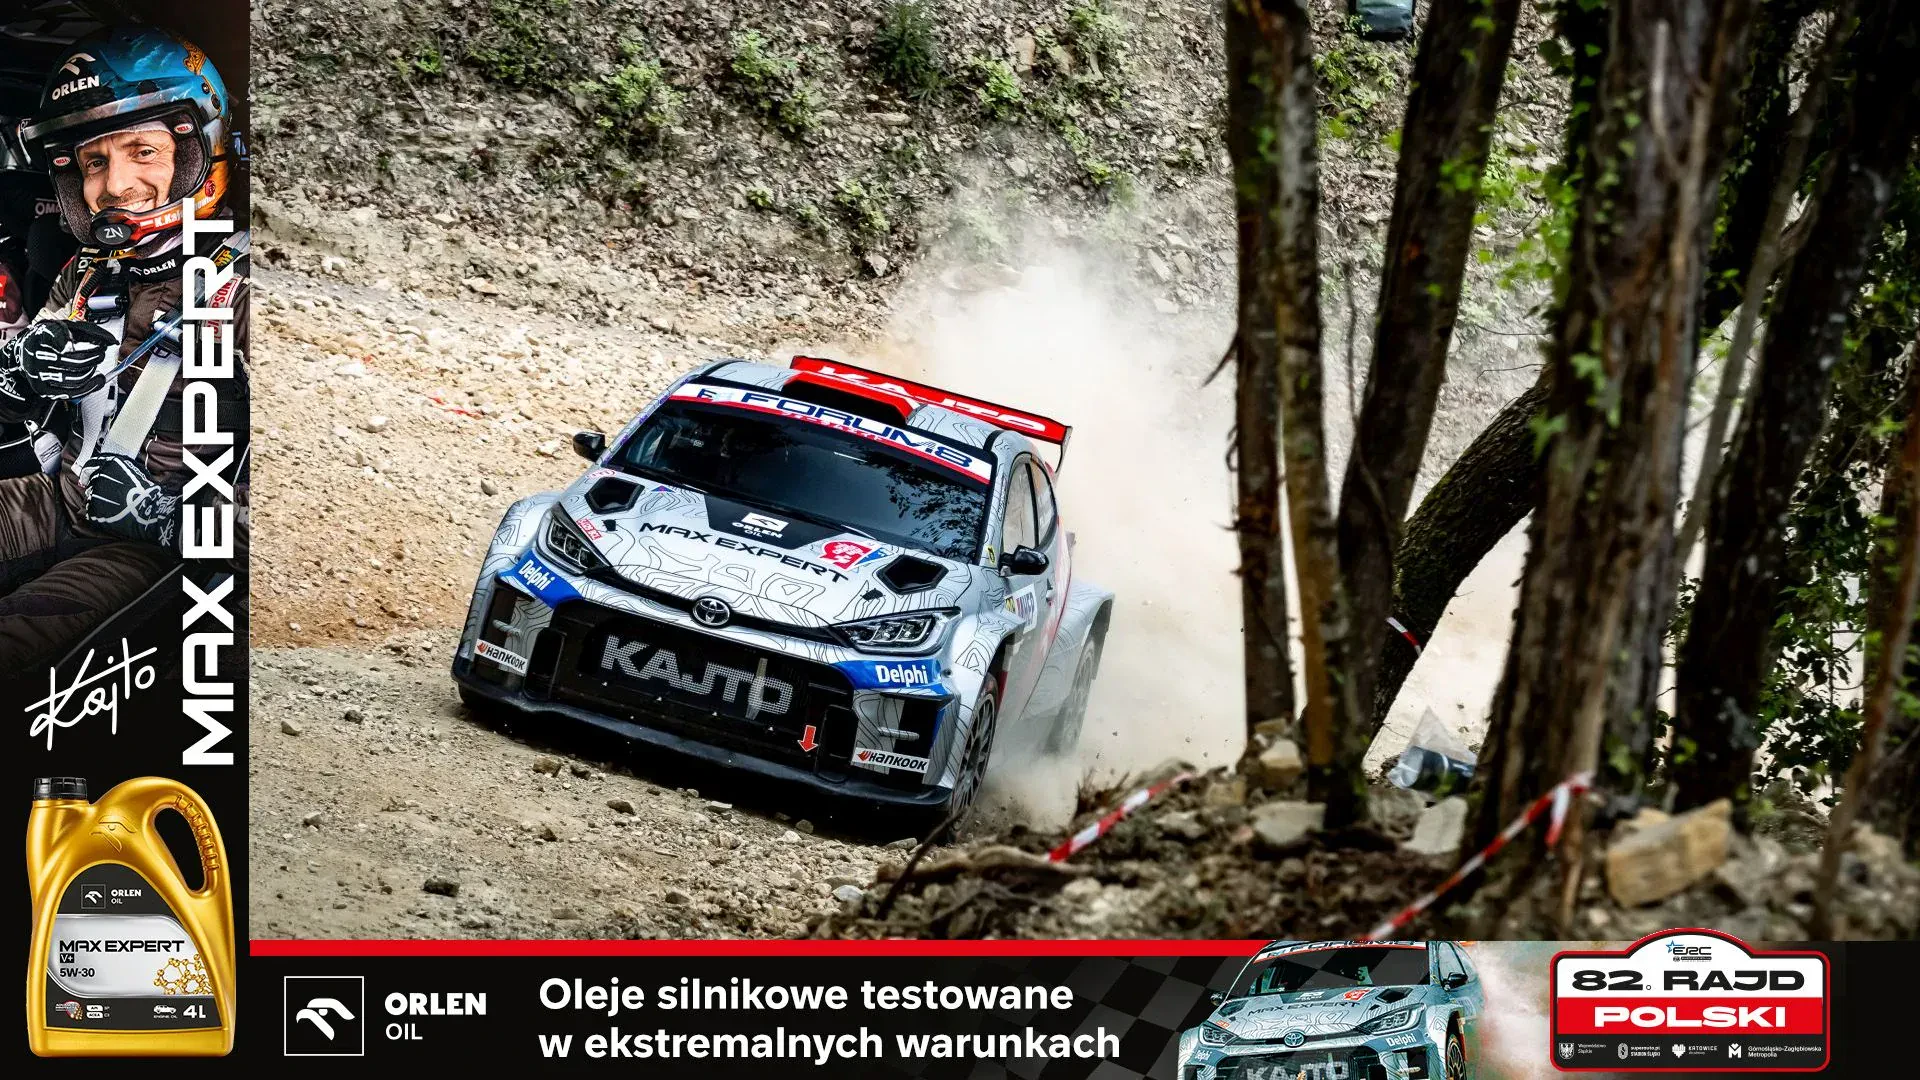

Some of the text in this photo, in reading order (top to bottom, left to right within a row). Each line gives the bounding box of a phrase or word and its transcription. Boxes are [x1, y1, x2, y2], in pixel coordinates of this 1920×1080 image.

[51, 75, 100, 100] ORLEN
[143, 258, 176, 276] ORLEN
[731, 522, 783, 538] ORLEN
[639, 522, 710, 544] MAX
[714, 537, 848, 583] EXPERT
[518, 559, 556, 592] Delphi
[600, 634, 794, 716] KAJTO
[875, 664, 929, 687] Delphi
[111, 889, 142, 897] ORLEN
[59, 940, 185, 953] MAX EXPERT
[61, 954, 73, 962] V+
[59, 968, 95, 978] 5W-30
[1386, 1032, 1417, 1047] Delphi
